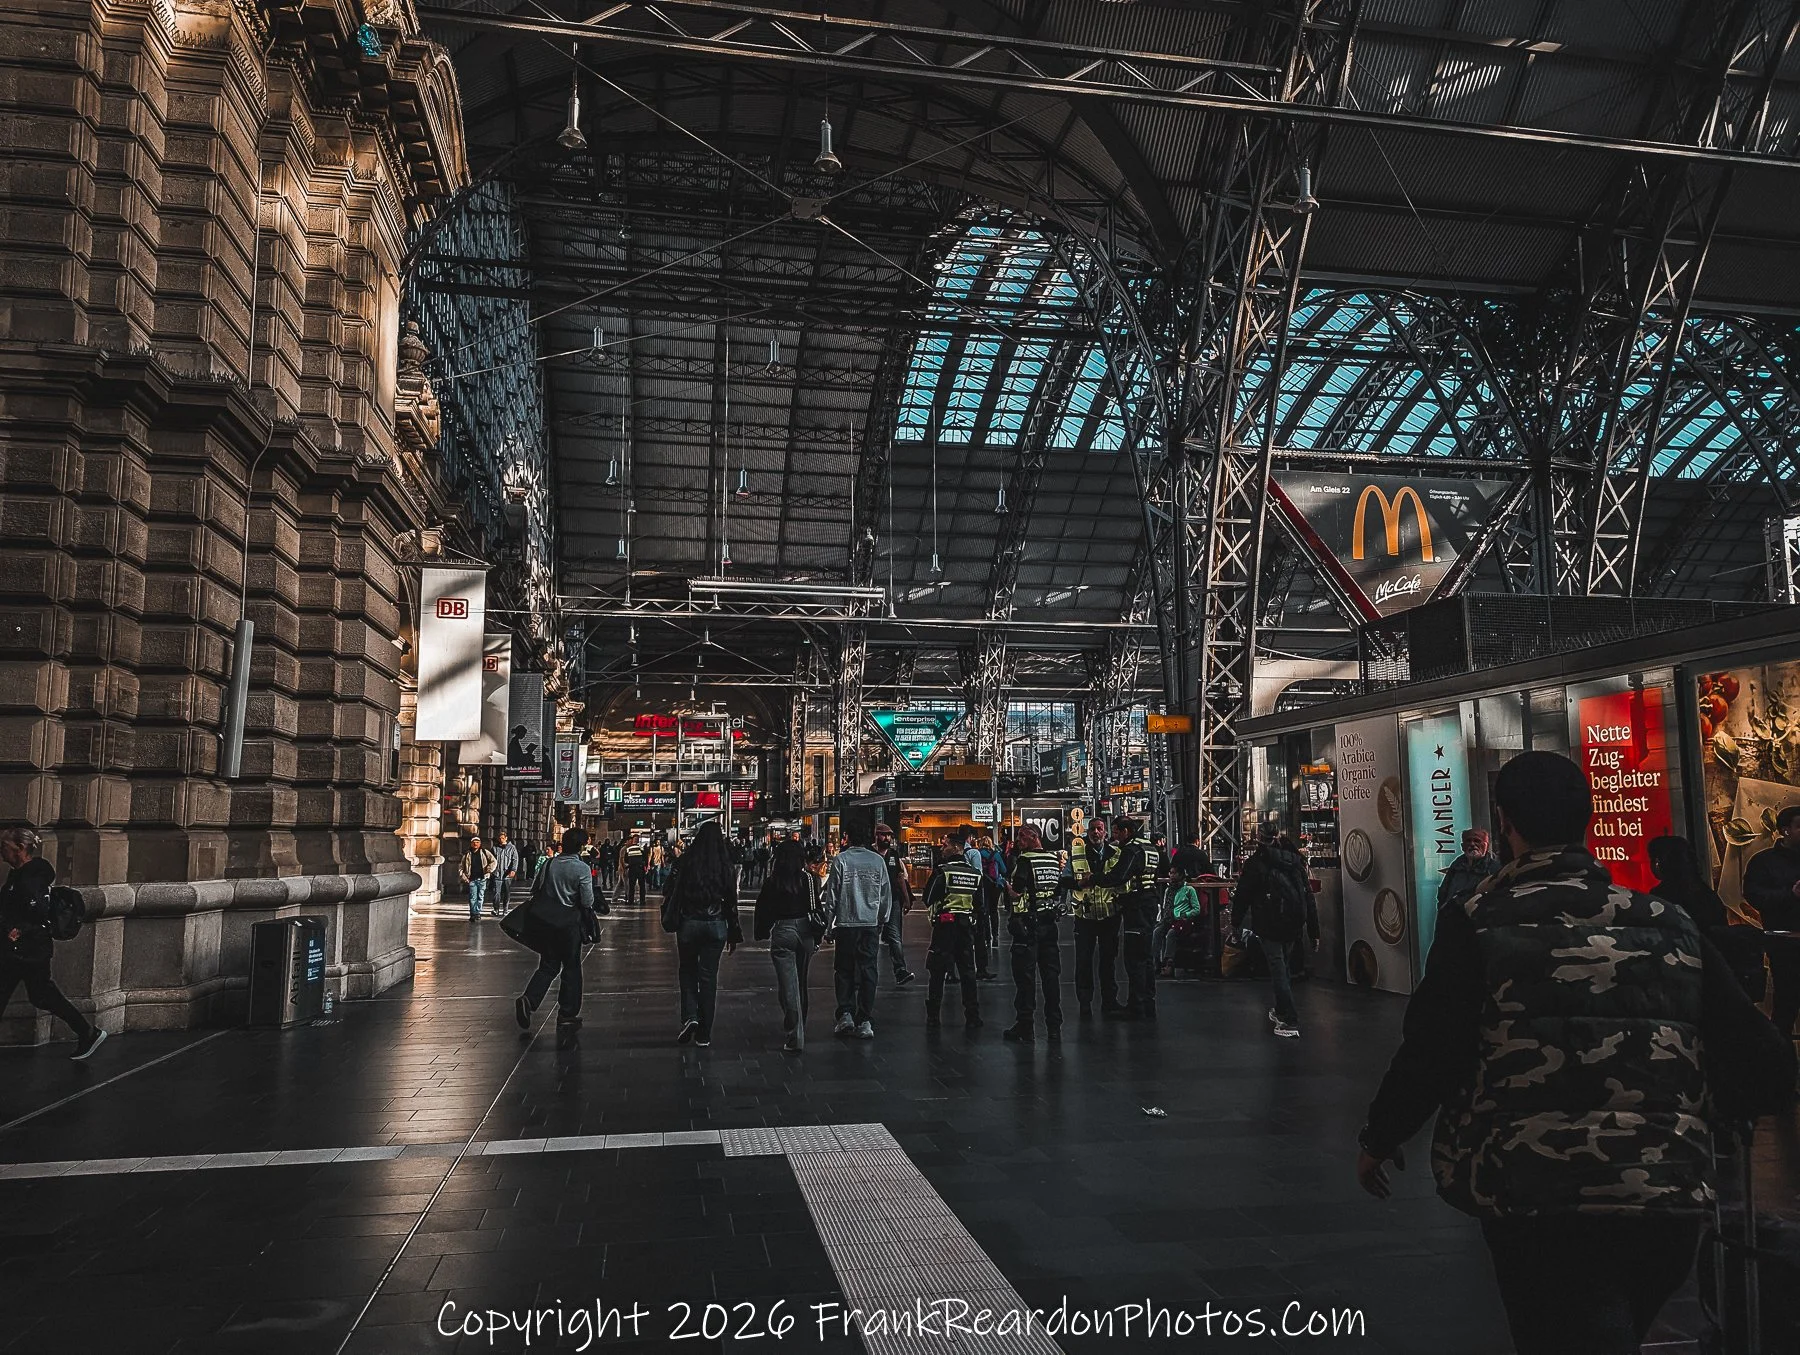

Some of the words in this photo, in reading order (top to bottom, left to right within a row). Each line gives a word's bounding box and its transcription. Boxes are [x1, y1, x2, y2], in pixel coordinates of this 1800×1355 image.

[1310, 485, 1322, 493] Am
[1323, 485, 1341, 494] Gleis
[1341, 486, 1351, 495] 22
[439, 600, 466, 617] DB
[896, 716, 936, 724] enterprise
[1340, 733, 1363, 748] 100%
[1587, 725, 1631, 743] Nette
[1341, 749, 1375, 765] Arabica
[1589, 748, 1625, 770] Zug-
[1341, 765, 1376, 784] Organic
[1590, 769, 1661, 793] begleiter
[1342, 785, 1370, 800] Coffee
[1431, 767, 1456, 855] MANGER
[1592, 794, 1649, 814] findest
[1593, 818, 1616, 837] du
[1617, 818, 1644, 837] bei
[1595, 846, 1630, 861] uns.
